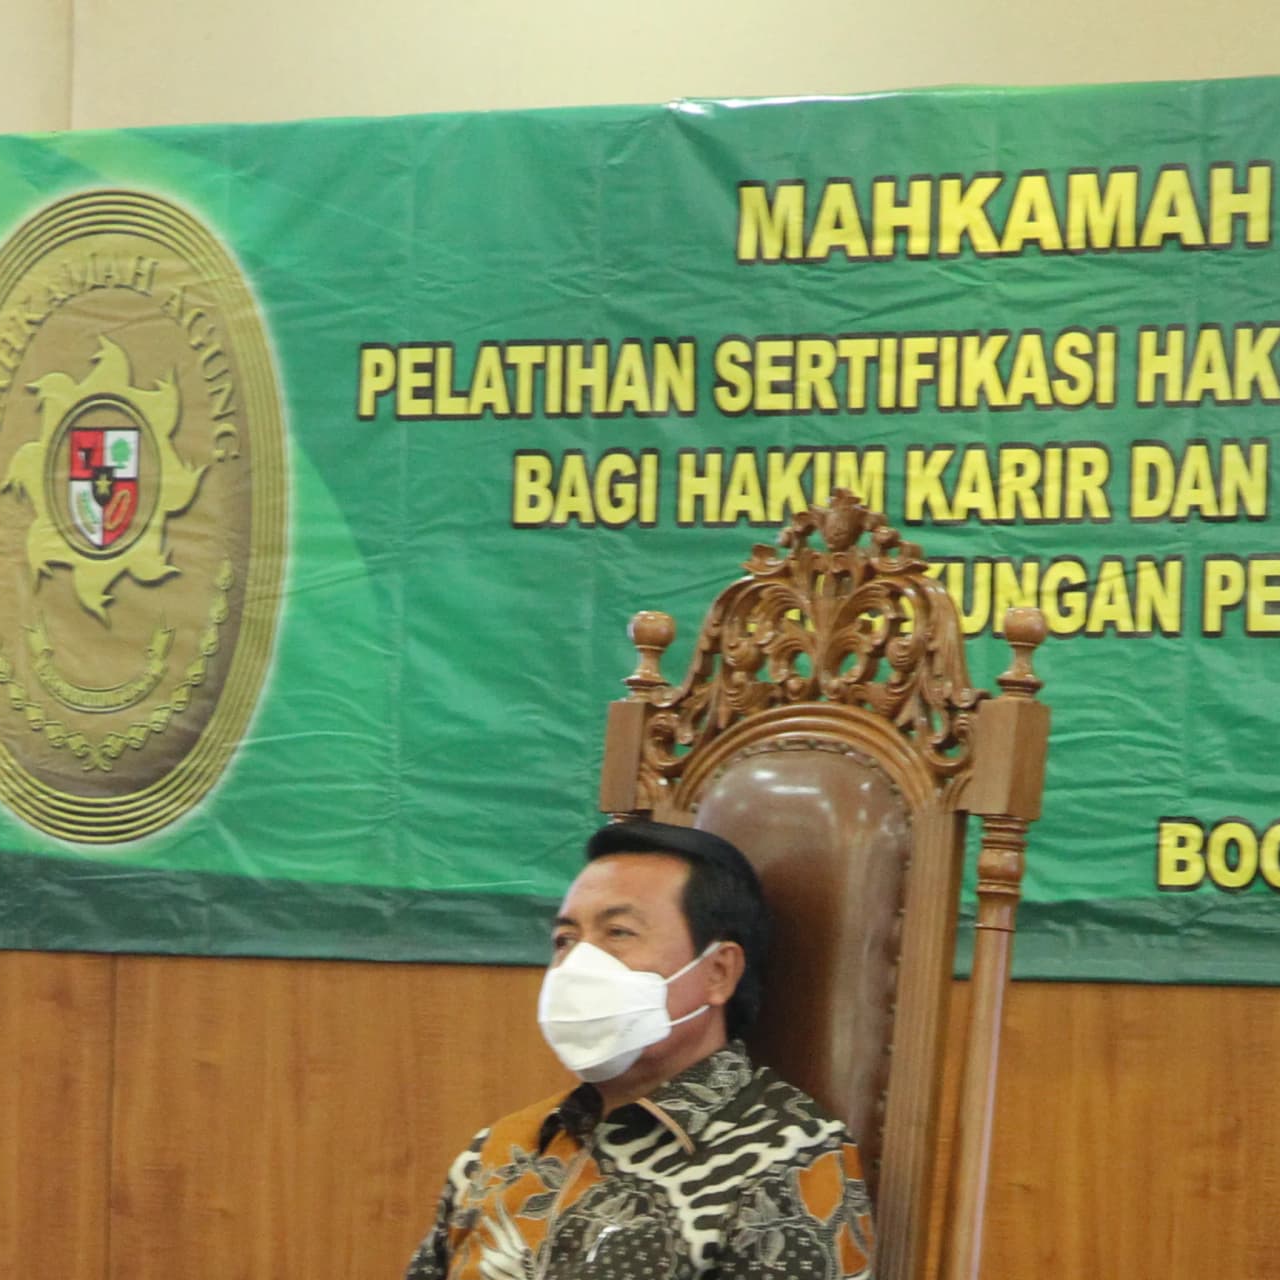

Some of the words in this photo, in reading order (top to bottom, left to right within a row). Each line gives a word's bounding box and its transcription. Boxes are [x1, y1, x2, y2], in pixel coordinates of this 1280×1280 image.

[736, 163, 1274, 263] MAHKAMAH
[161, 283, 241, 463] AGUNG
[357, 340, 697, 419] PELATIHAN
[713, 329, 1118, 415] SERTIFIKASI
[512, 450, 660, 527] BAGI
[676, 448, 888, 525] HAKIM
[903, 444, 1113, 524] KARIR
[1129, 441, 1270, 521] DAN
